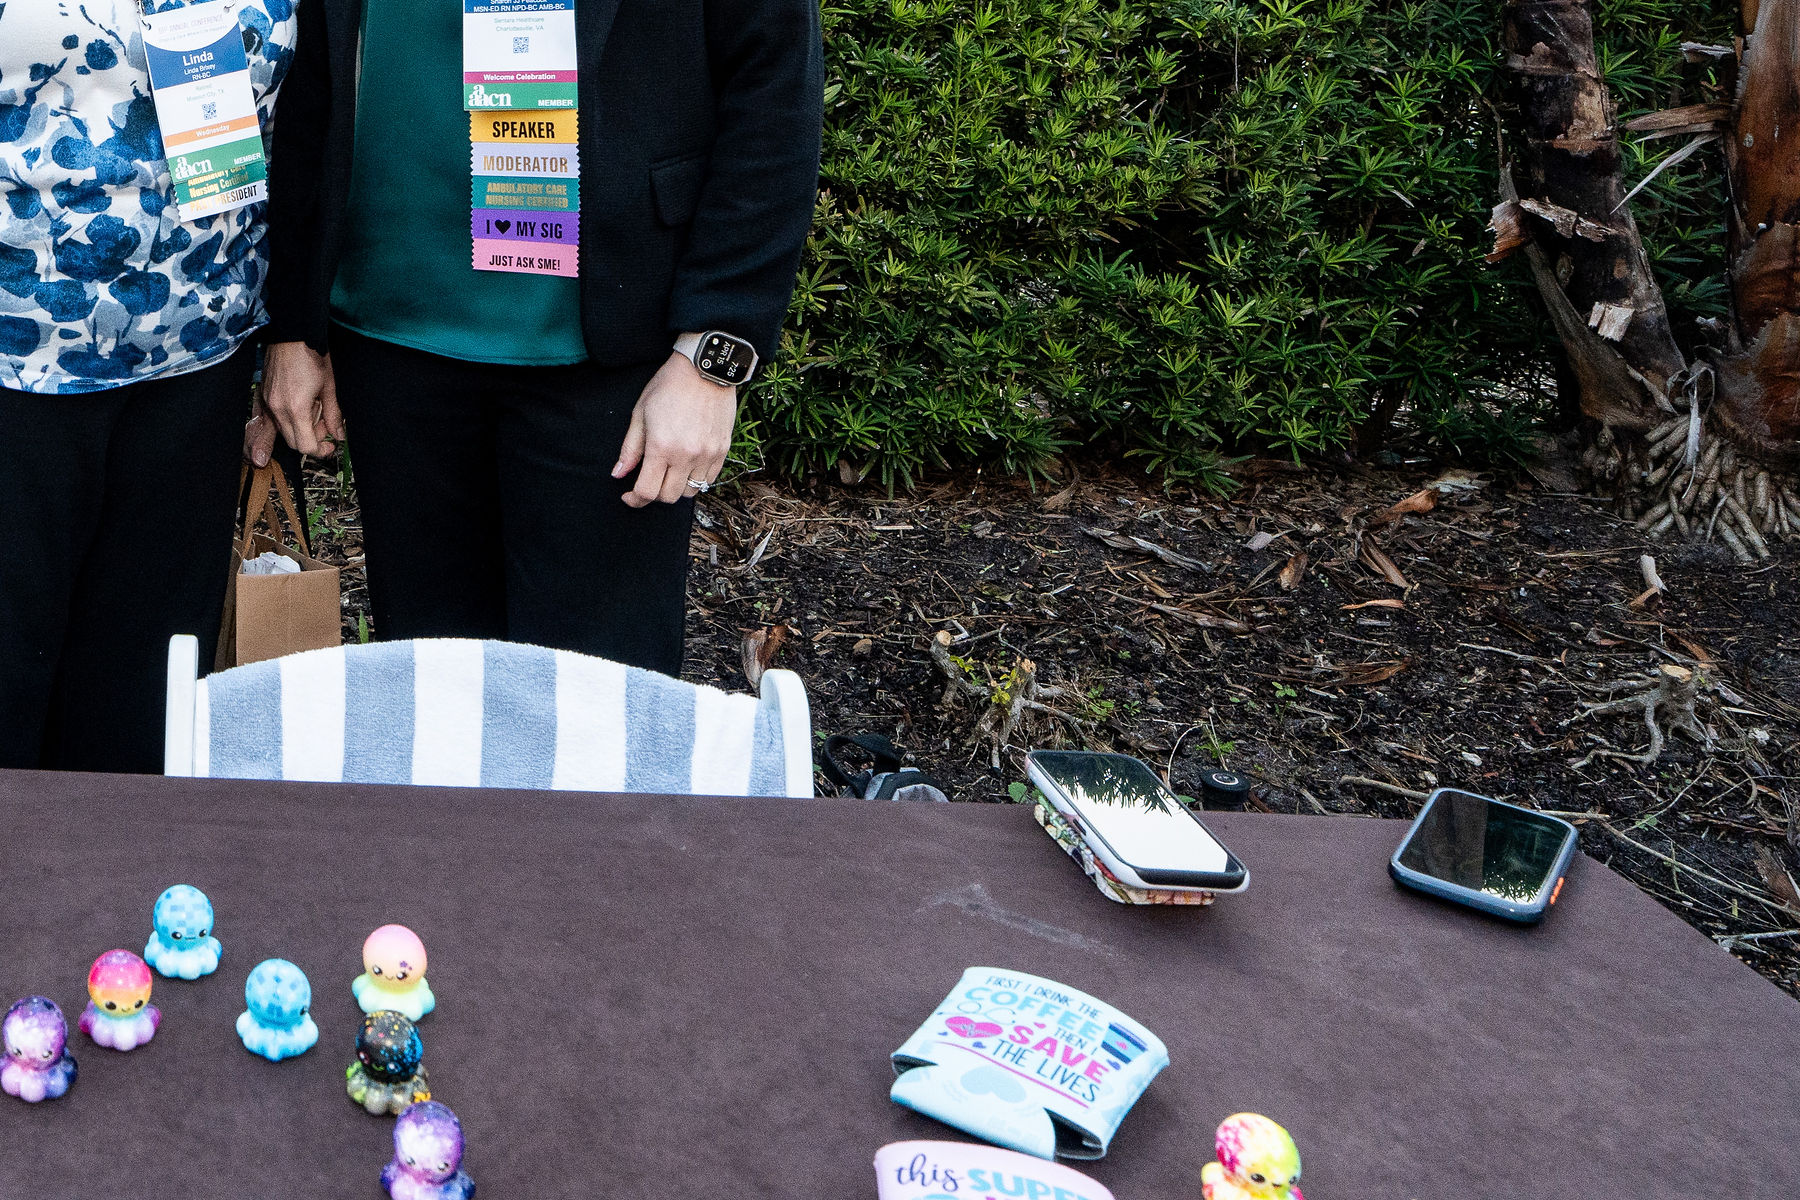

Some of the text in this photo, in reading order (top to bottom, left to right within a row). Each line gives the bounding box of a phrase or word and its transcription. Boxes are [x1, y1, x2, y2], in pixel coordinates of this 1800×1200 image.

[182, 51, 214, 67] Linda
[184, 67, 199, 75] Linda
[192, 71, 211, 81] RN-BC
[196, 124, 230, 137] Wednesday
[492, 121, 555, 138] SPEAKER
[233, 152, 262, 165] MEMBER
[483, 156, 568, 173] MODERATOR
[189, 171, 249, 199] Nursing Certified
[487, 182, 567, 195] AMBULATORY CARE
[215, 185, 257, 207] PRESIDENT
[486, 219, 563, 239] I MY SIG
[489, 254, 560, 271] JUST ASK SME!
[720, 341, 731, 357] APR
[716, 356, 725, 365] 15
[727, 361, 739, 377] 7:25
[986, 975, 1103, 1019] FIRST I DRINK THE
[965, 987, 1104, 1042] COFFEE
[1054, 1027, 1098, 1056] THEN I
[1008, 1025, 1110, 1084] SAVE
[992, 1039, 1100, 1103] THE LIVES
[895, 1153, 1090, 1200] this SUPE
